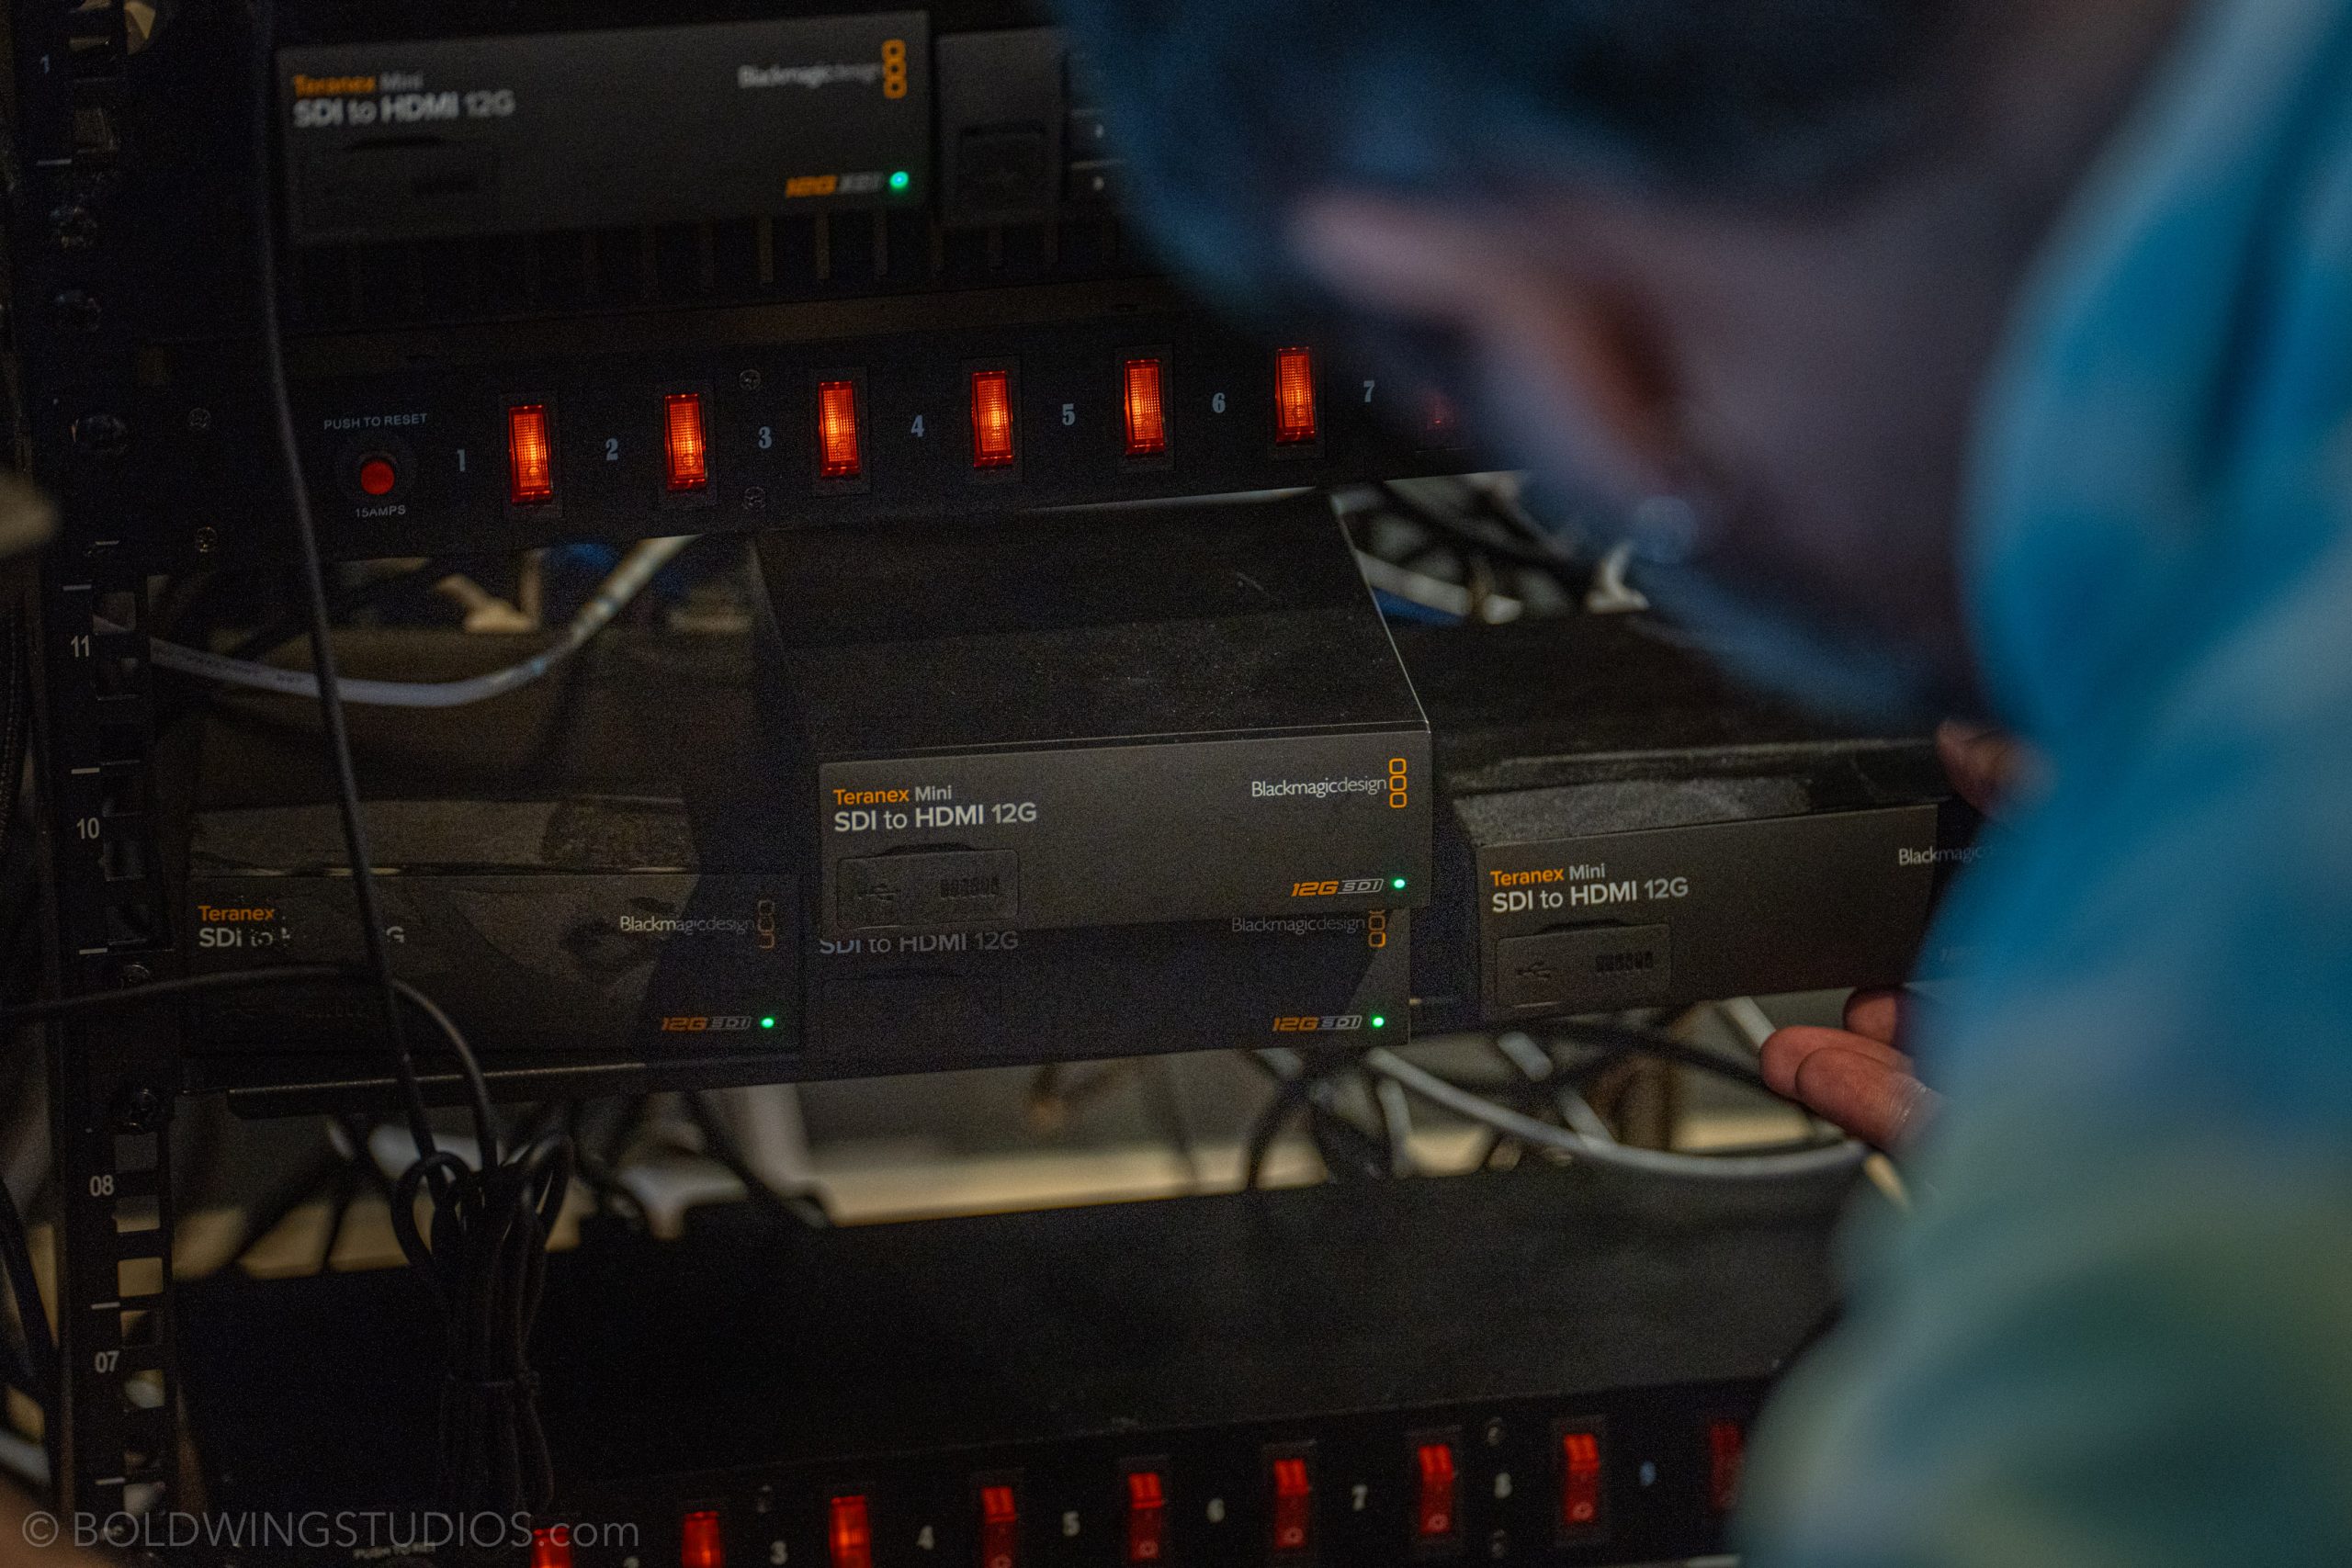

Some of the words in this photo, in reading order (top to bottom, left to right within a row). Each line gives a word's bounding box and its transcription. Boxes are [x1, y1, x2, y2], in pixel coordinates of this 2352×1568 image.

[293, 97, 344, 128] SDI
[347, 98, 378, 127] to
[380, 91, 459, 123] HDMI
[464, 89, 516, 118] 12G
[323, 418, 361, 431] PUSH
[363, 415, 382, 428] TO
[384, 412, 428, 426] RESET
[456, 447, 467, 473] 1
[605, 436, 619, 461] 2
[757, 425, 773, 449] 3
[910, 414, 926, 438] 4
[1060, 402, 1076, 426] 5
[1211, 391, 1227, 414] 6
[1363, 379, 1375, 403] 7
[355, 504, 407, 519] 15AMPS
[71, 634, 90, 659] 11
[833, 788, 910, 807] Teranex
[915, 784, 953, 803] Mini
[1250, 776, 1387, 799] Blackmagicdesign
[76, 817, 101, 840] 10
[834, 809, 877, 833] SDI
[883, 810, 909, 830] to
[914, 803, 985, 829] HDMI
[991, 801, 1037, 825] 12G
[1489, 868, 1565, 887] Teranex
[1568, 863, 1606, 882] Mini
[1491, 889, 1534, 914] SDI
[1539, 888, 1565, 910] to
[1569, 879, 1638, 908] HDMI
[1644, 875, 1690, 901] 12G
[197, 904, 276, 922] Teranex
[198, 926, 243, 949] SDI
[1230, 916, 1366, 937] Blackmagicdesign
[868, 936, 891, 954] to
[899, 932, 967, 953] HDMI
[974, 930, 1020, 952] 12G
[89, 1174, 115, 1198] 08
[94, 1350, 120, 1374] 07
[770, 1540, 787, 1565] 3
[917, 1524, 935, 1551] 4
[1062, 1509, 1080, 1538] 5
